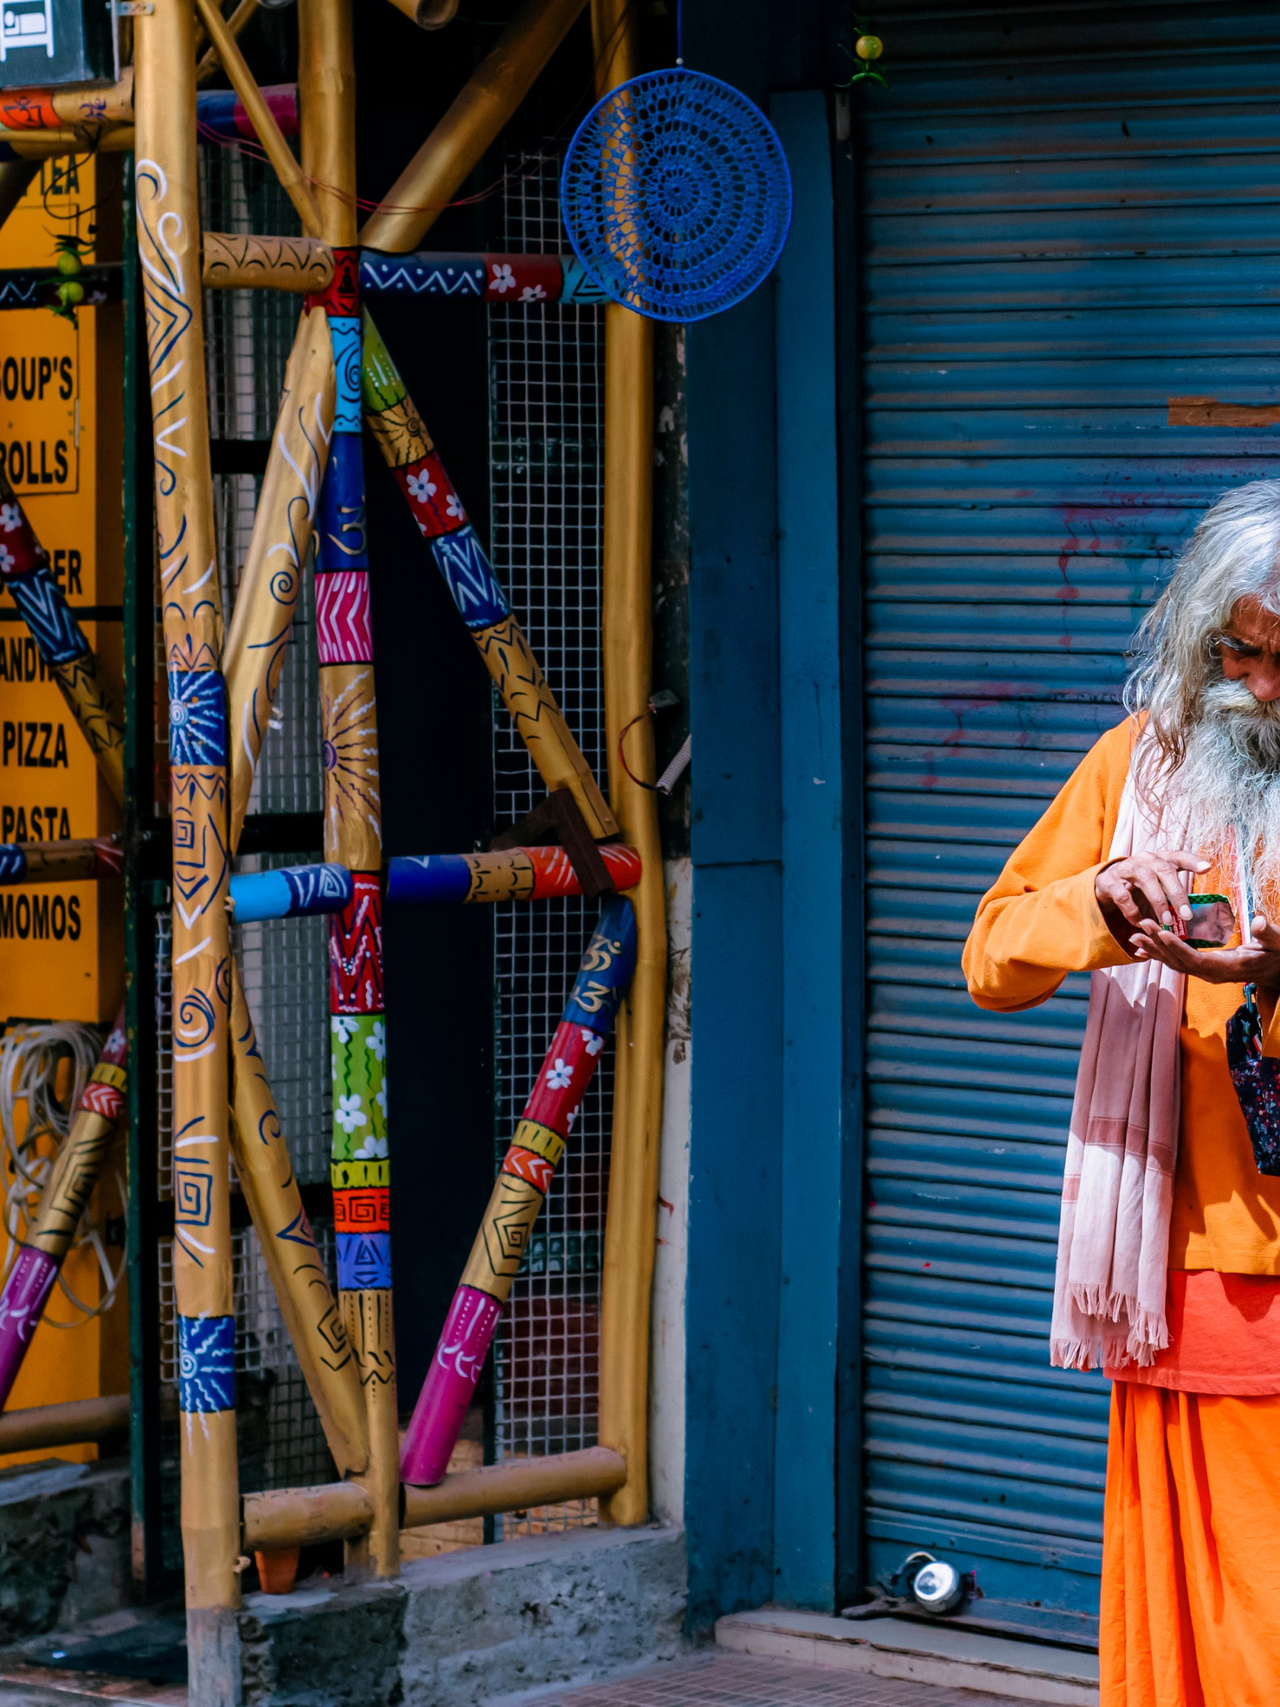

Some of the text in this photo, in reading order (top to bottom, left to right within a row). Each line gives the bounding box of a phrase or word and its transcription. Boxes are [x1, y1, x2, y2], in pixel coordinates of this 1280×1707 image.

[0, 356, 73, 403] OUP'S
[3, 721, 69, 769] PIZZA
[2, 806, 71, 843] PASTA
[0, 894, 82, 942] MOMOS
